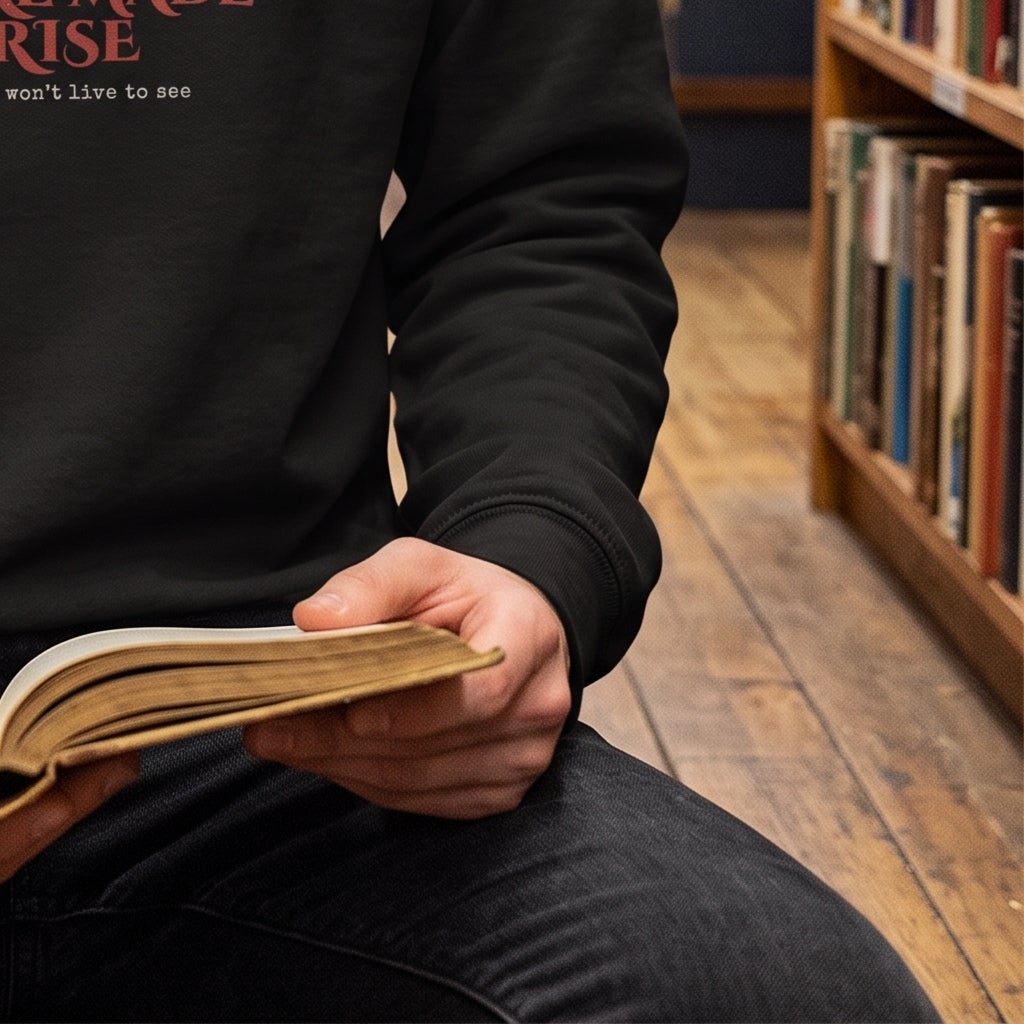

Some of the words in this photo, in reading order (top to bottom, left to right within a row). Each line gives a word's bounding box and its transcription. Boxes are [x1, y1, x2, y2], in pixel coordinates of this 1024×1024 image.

[4, 83, 62, 101] won't
[68, 83, 117, 100] live
[125, 83, 149, 100] to
[156, 85, 191, 99] see
